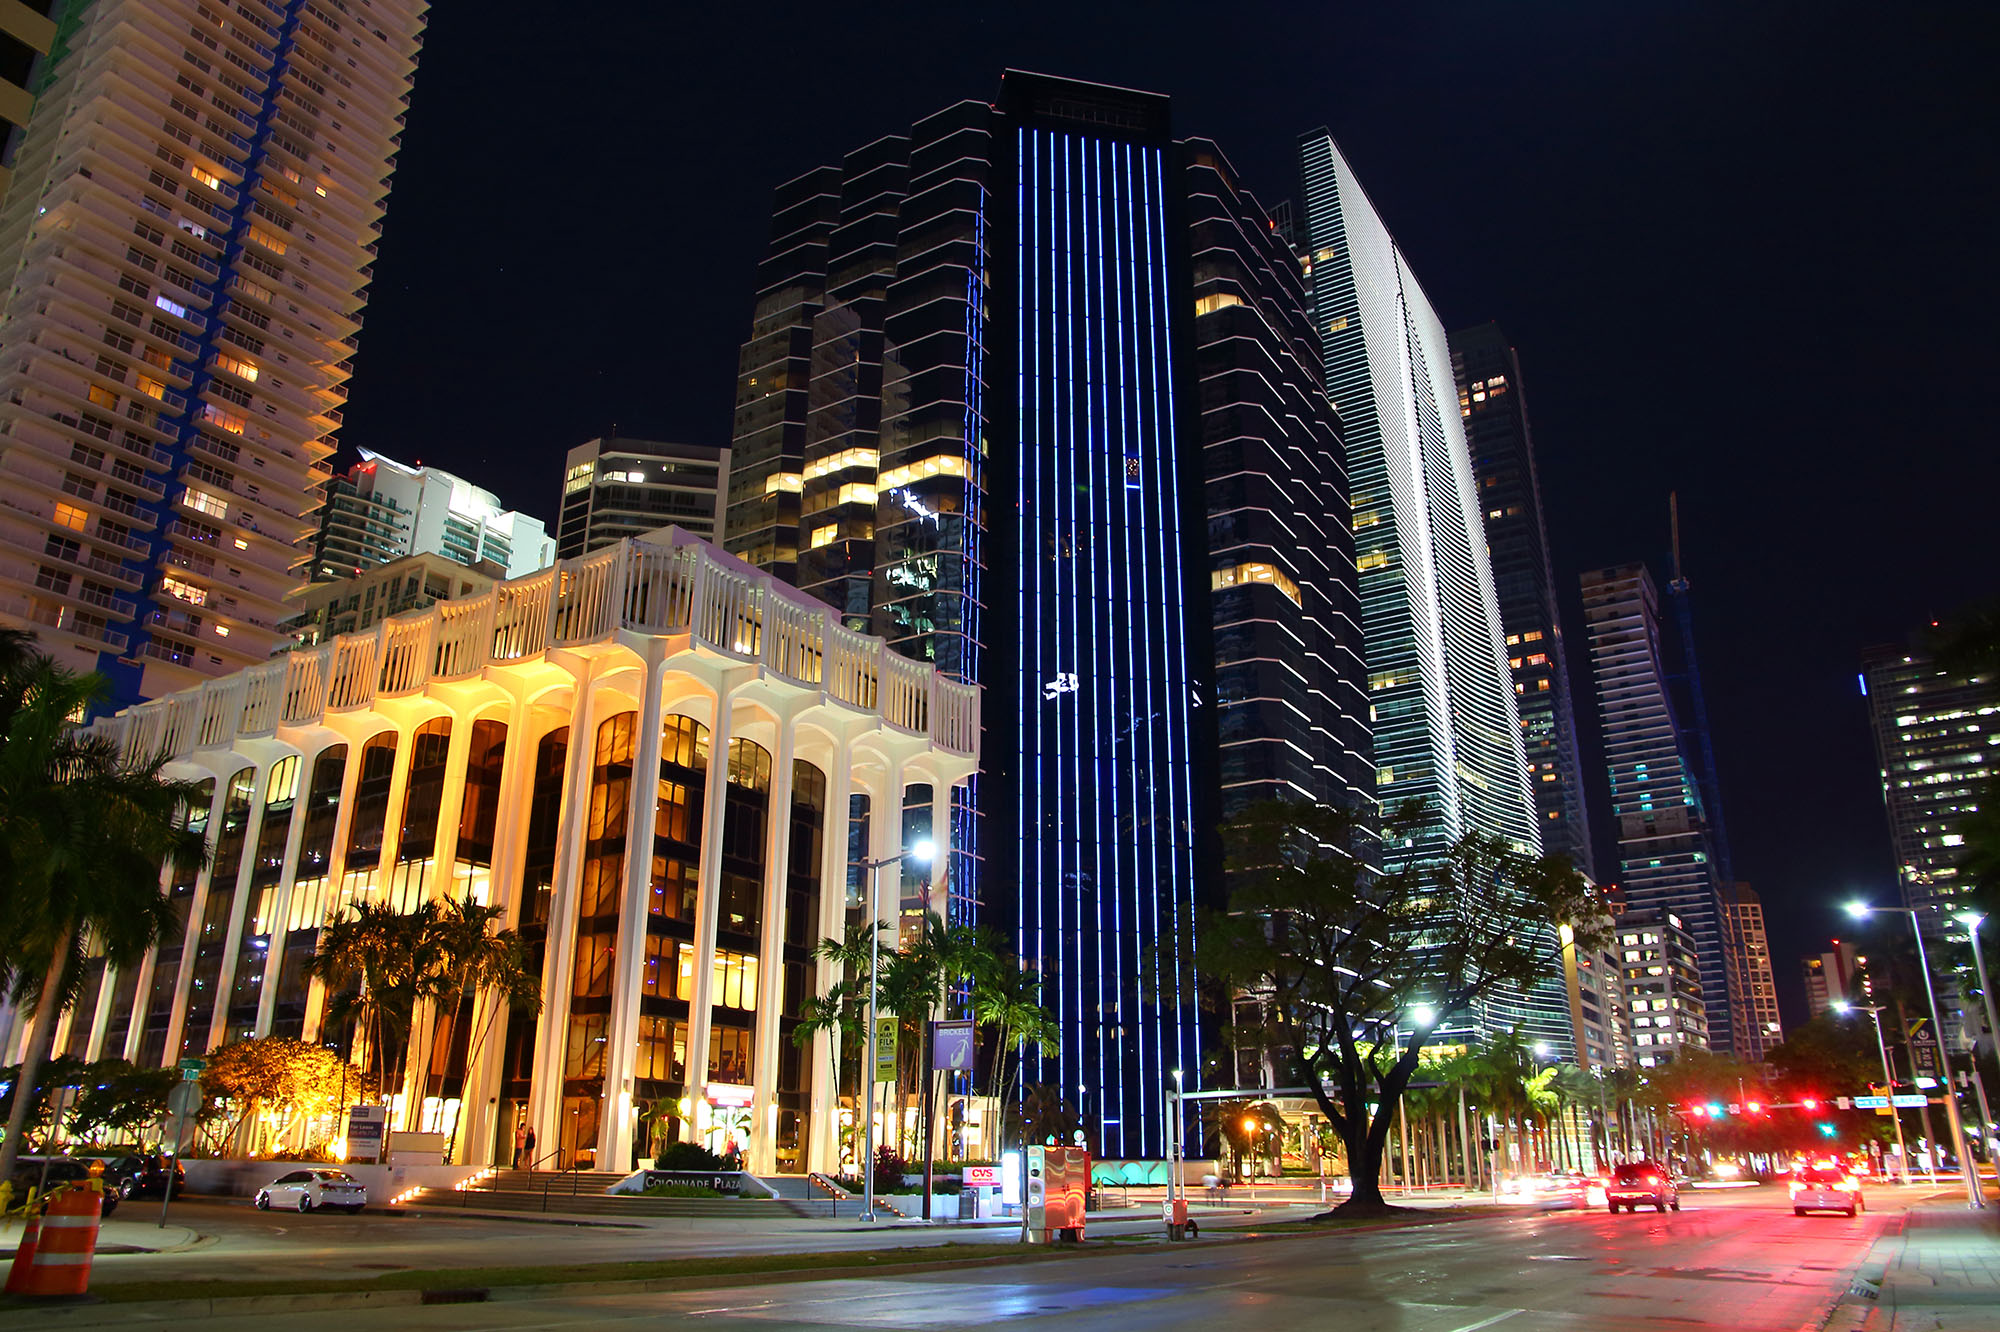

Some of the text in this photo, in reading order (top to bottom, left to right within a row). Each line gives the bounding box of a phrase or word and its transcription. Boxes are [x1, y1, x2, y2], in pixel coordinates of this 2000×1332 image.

[939, 1028, 970, 1036] BRICKELL
[879, 1038, 895, 1046] FILM
[972, 1169, 993, 1177] CVS
